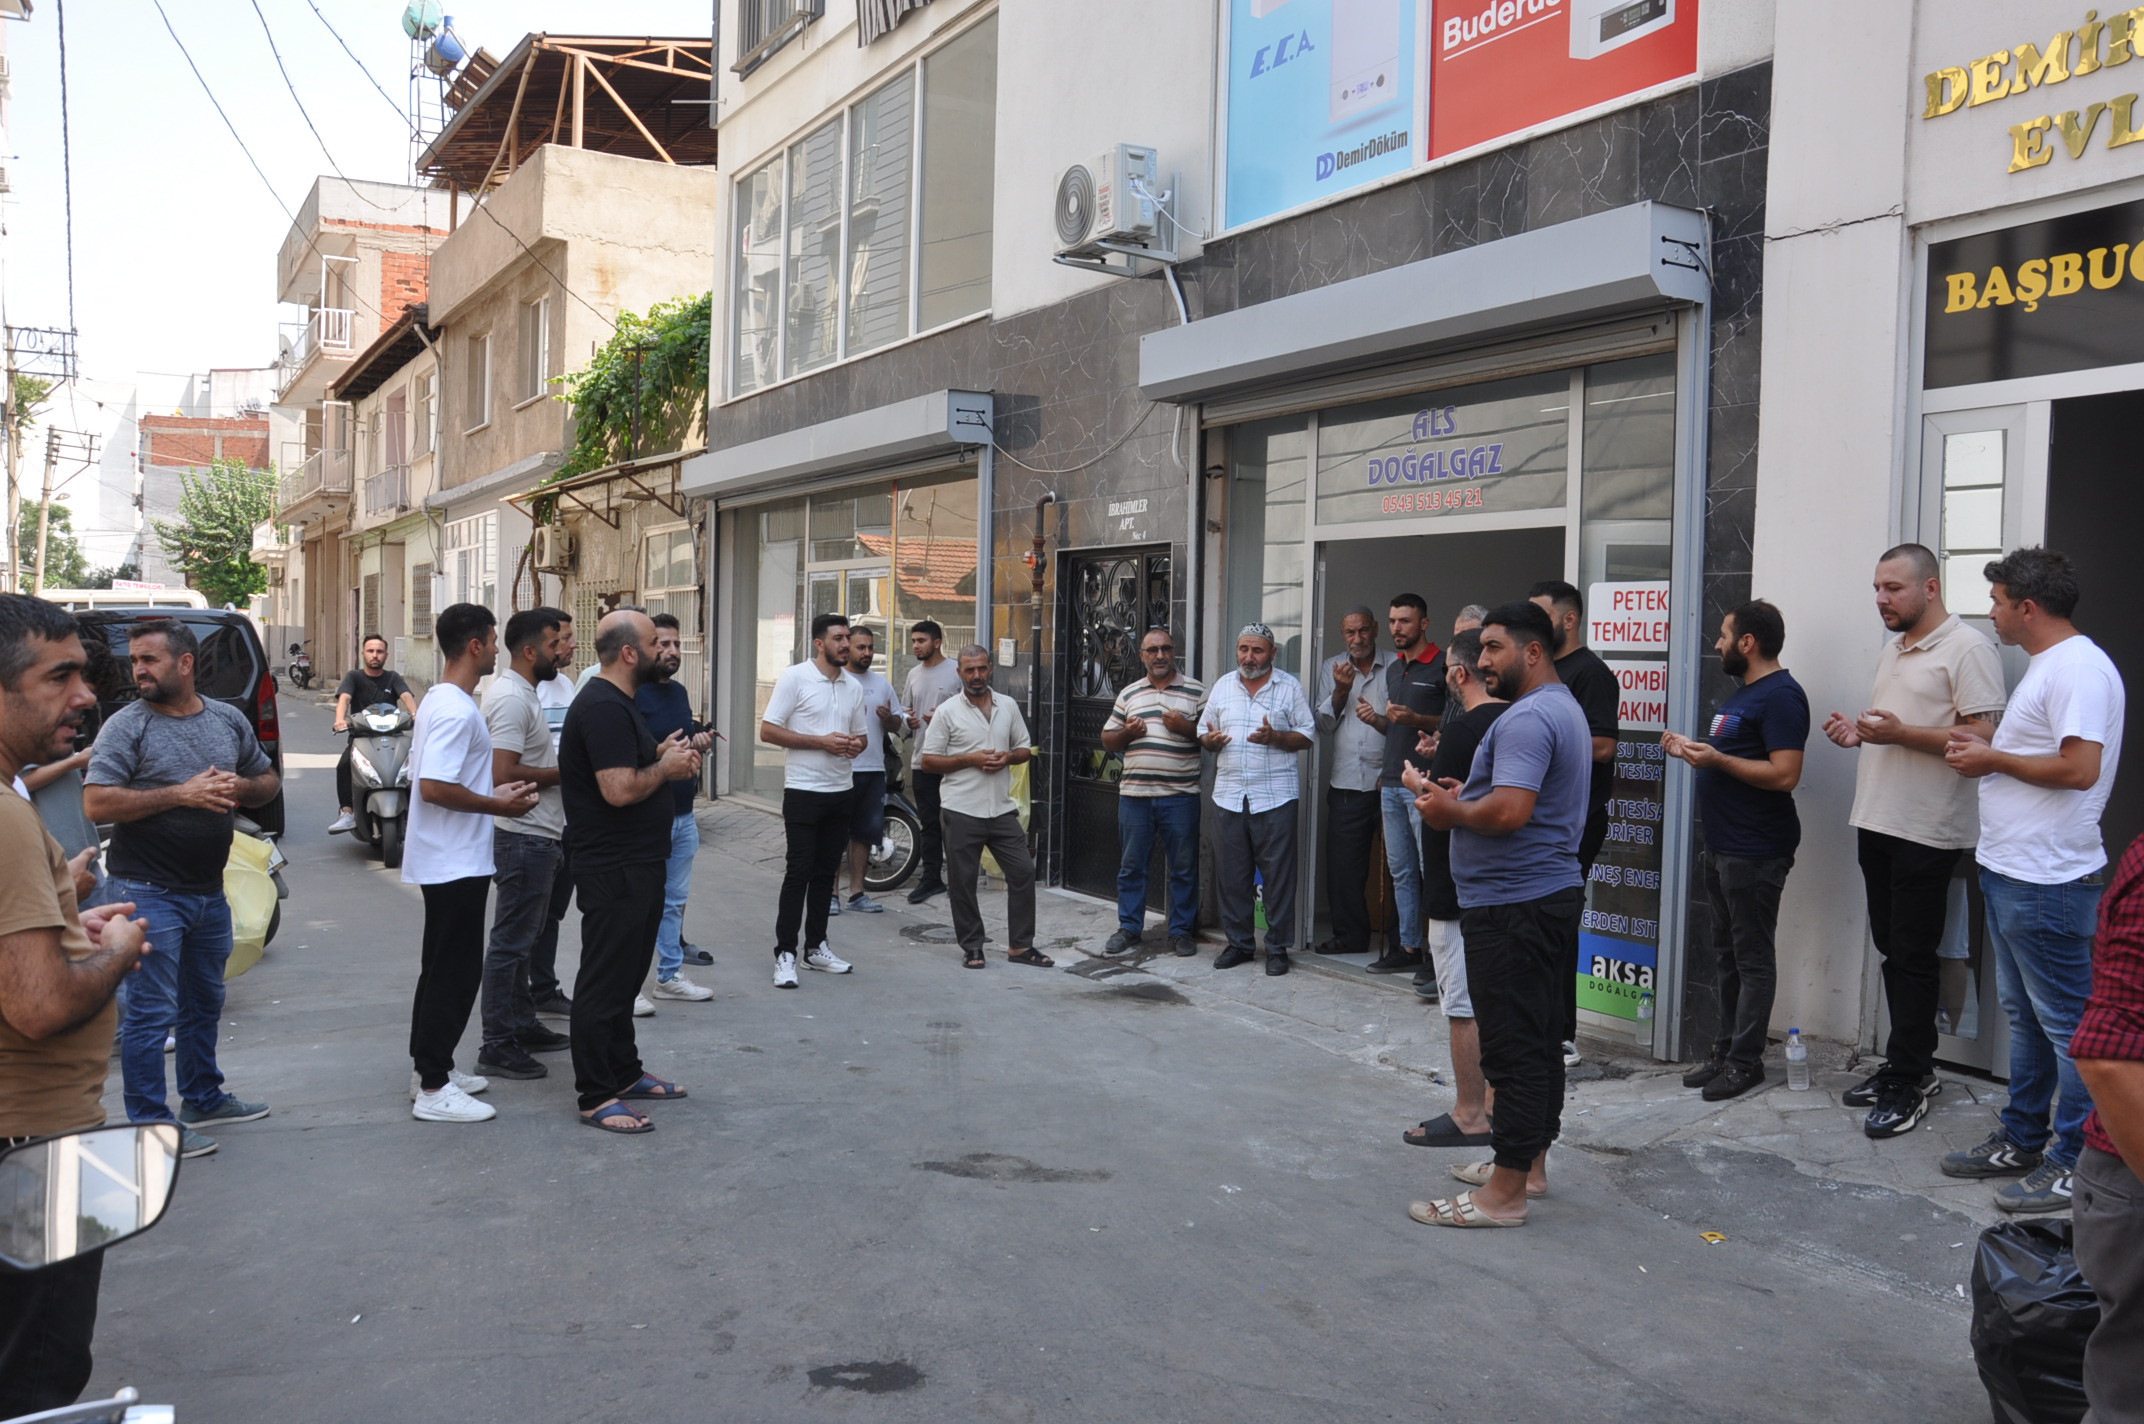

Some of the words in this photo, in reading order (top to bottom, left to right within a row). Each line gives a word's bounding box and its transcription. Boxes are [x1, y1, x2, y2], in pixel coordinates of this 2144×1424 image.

[1922, 7, 2144, 119] DEMİR
[1336, 130, 1408, 171] DemirDöküm
[1412, 406, 1456, 442] ALS
[1368, 443, 1503, 485] DOĞALGAZ
[1382, 493, 1415, 514] 0543
[1417, 491, 1443, 511] 513
[1444, 489, 1463, 509] 45
[1464, 487, 1483, 507] 21
[1613, 589, 1668, 611] PETEK
[1617, 741, 1635, 758] SU
[1618, 760, 1664, 781] TESİSA
[1592, 955, 1654, 990] aksa
[1589, 980, 1654, 1001] DOĞALG
